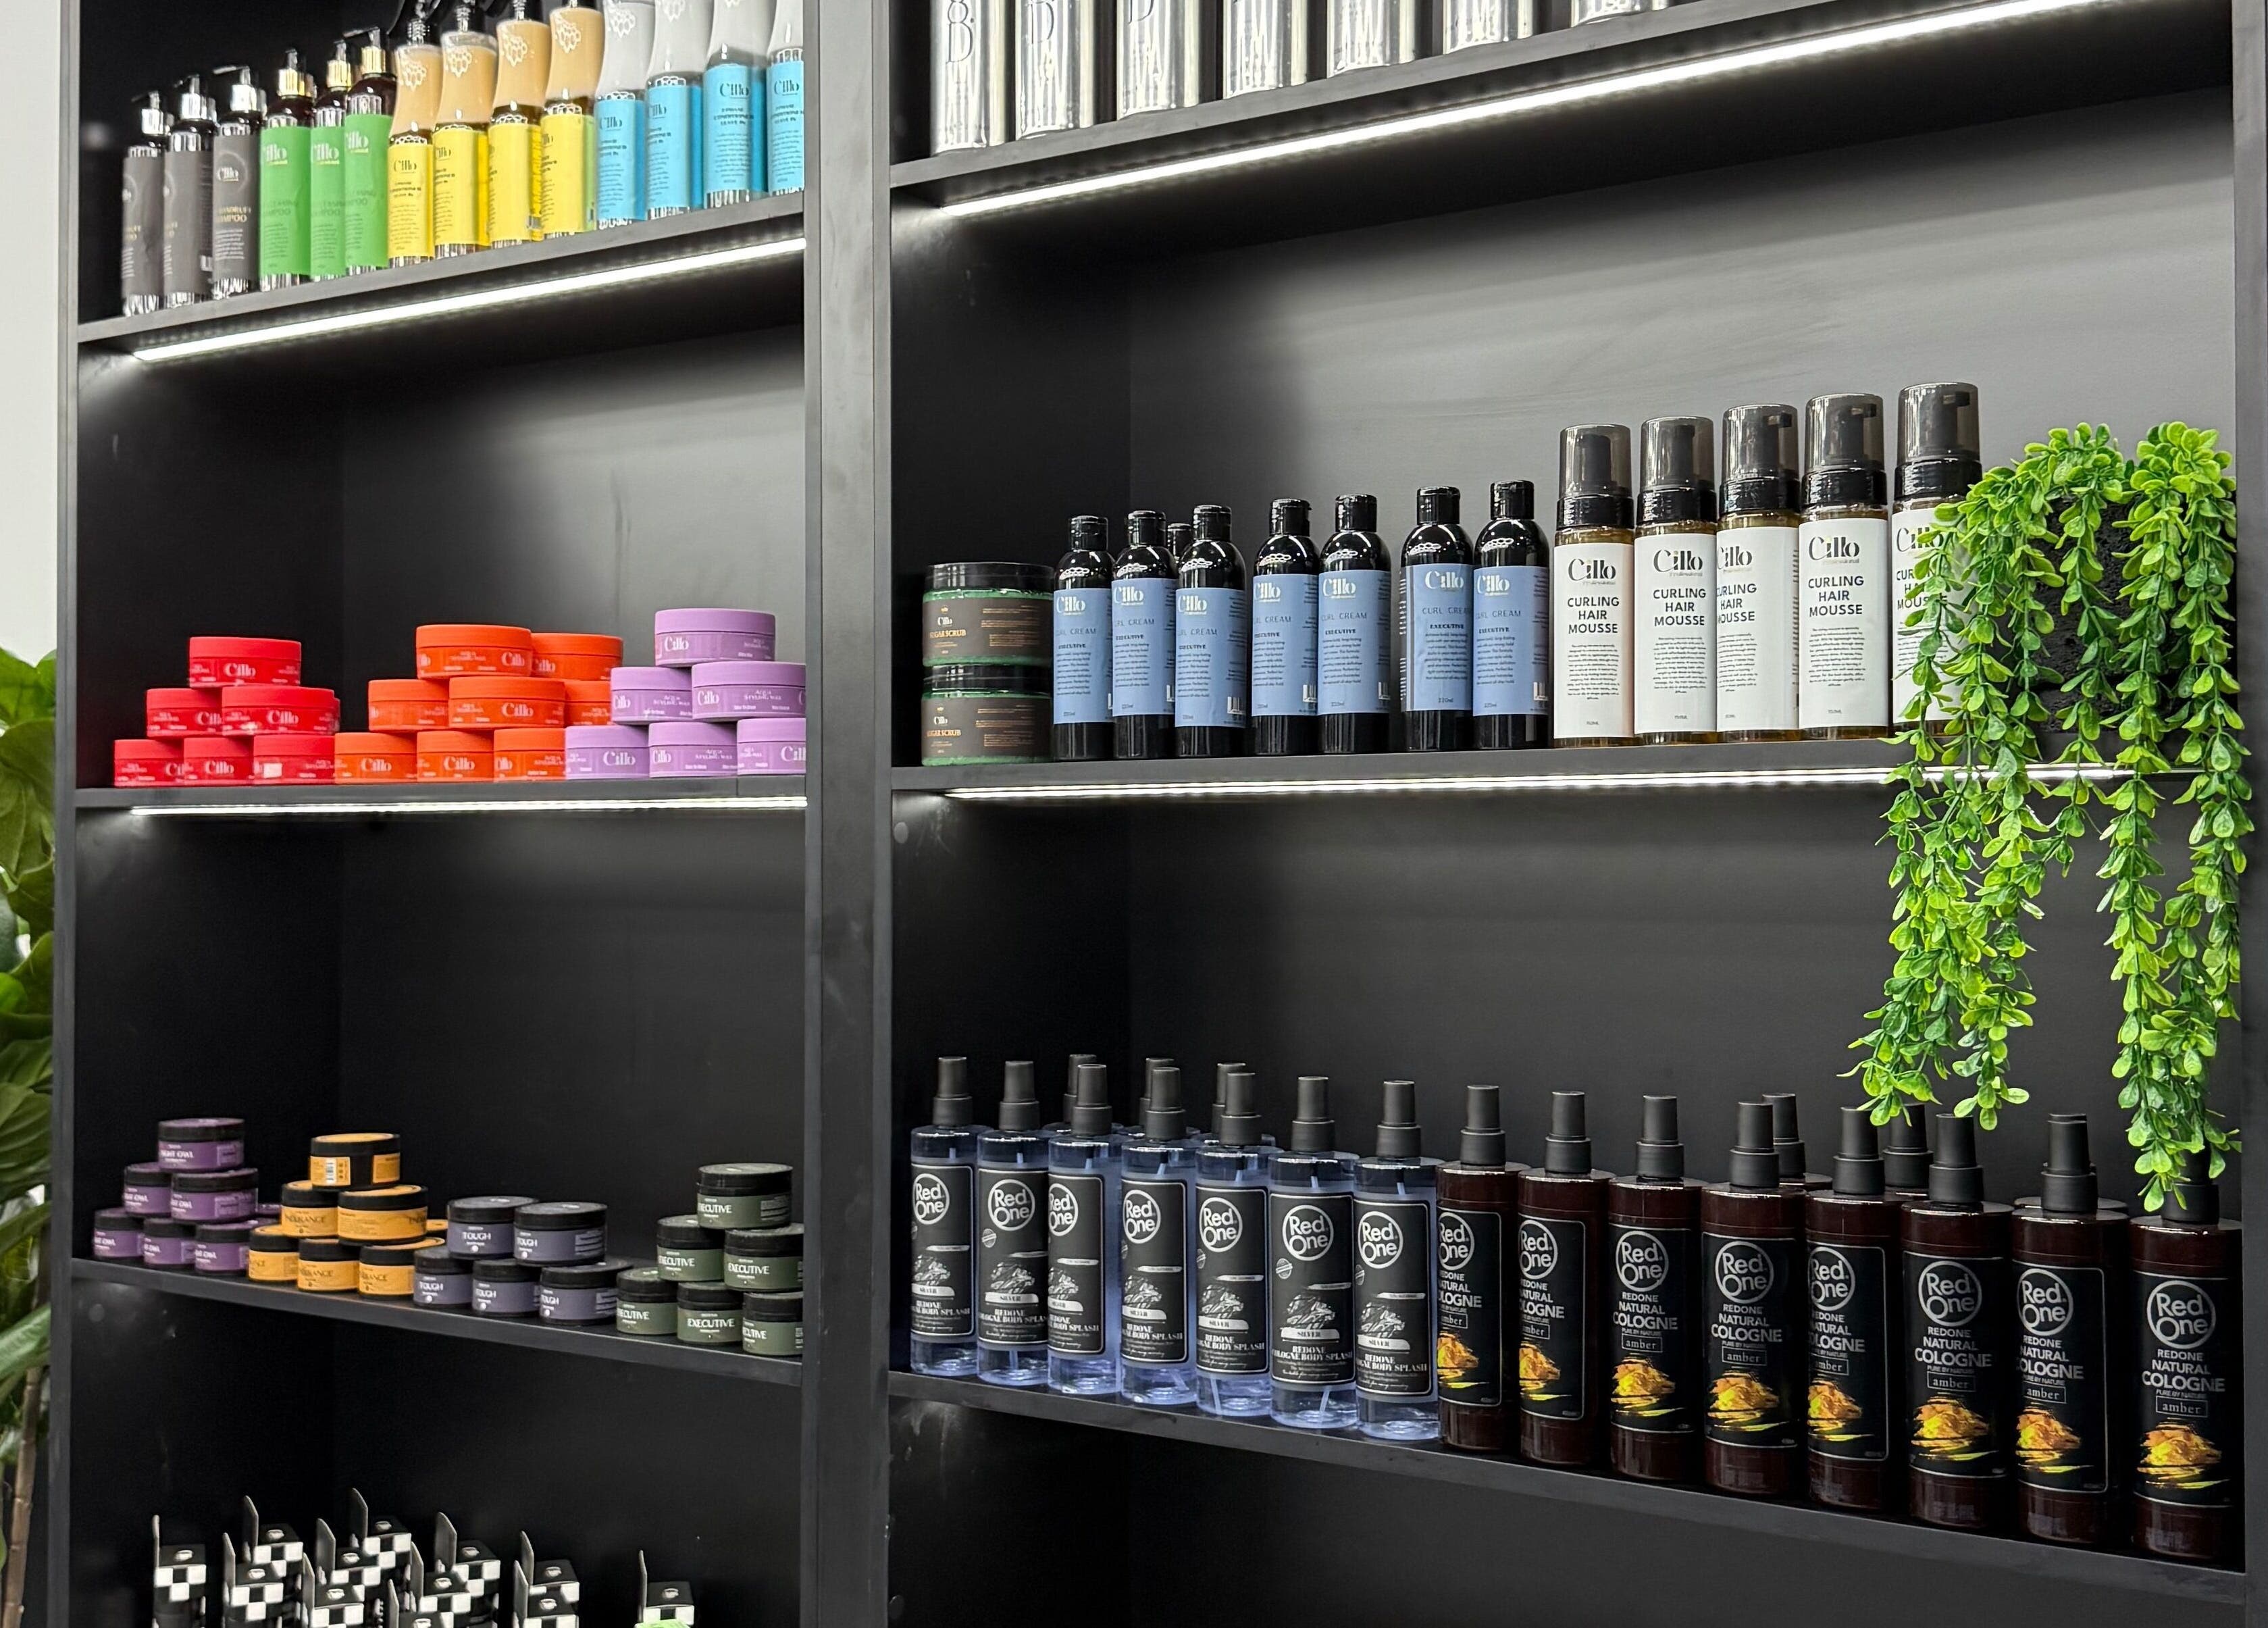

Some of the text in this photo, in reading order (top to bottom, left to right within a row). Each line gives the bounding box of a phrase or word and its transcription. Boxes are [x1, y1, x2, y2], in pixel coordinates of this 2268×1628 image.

[1809, 536, 1859, 561] Cillo
[1653, 549, 1703, 573] Cillo
[1568, 558, 1616, 581] Cillo
[1322, 578, 1356, 596] Cillo
[1425, 571, 1464, 589] Cillo
[1476, 574, 1510, 594] Cillo
[1808, 576, 1864, 588] CURLING
[1653, 588, 1706, 599] CURLING
[1819, 590, 1850, 602] HAIR
[1567, 596, 1620, 607] CURLING
[1666, 602, 1695, 612] HAIR
[1720, 598, 1743, 610] HAIR
[1339, 611, 1368, 619] CREAM
[1492, 610, 1521, 618] CREAM
[1578, 610, 1607, 620] HAIR
[1809, 604, 1863, 617] MOUSSE
[1129, 618, 1155, 626] CREAM
[1265, 615, 1291, 624] CREAM
[1654, 615, 1705, 626] MOUSSE
[1568, 624, 1618, 634] MOUSSE
[664, 636, 689, 652] Cillo
[224, 663, 256, 677] Cillo
[500, 702, 534, 717] Cillo
[266, 710, 299, 725] Cillo
[361, 757, 392, 772] Cillo
[443, 756, 475, 771] Cillo
[603, 751, 636, 766] Cillo
[205, 761, 235, 775] Cillo
[916, 1183, 942, 1200] Red
[994, 1189, 1027, 1207] Red
[915, 1200, 944, 1218] One
[994, 1206, 1030, 1225] One
[1126, 1200, 1152, 1218] Red
[1204, 1207, 1233, 1227] Red
[1125, 1218, 1156, 1237] One
[1289, 1215, 1325, 1236] Red
[1362, 1222, 1394, 1242] Red
[462, 1231, 492, 1240] TOUGH
[1202, 1227, 1237, 1246] One
[1289, 1235, 1328, 1255] One
[1362, 1242, 1397, 1262] One
[1622, 1242, 1658, 1264] Red
[727, 1263, 771, 1275] EXECUTIVE
[1722, 1252, 1763, 1275] Red
[1620, 1263, 1663, 1285] One
[419, 1281, 444, 1291] TOUGH
[1722, 1274, 1768, 1297] One
[1926, 1273, 1970, 1296] Red
[1622, 1292, 1659, 1303] REDONE
[2021, 1281, 2062, 1304] Red
[1618, 1301, 1666, 1315] NATURAL
[1723, 1304, 1764, 1315] REDONE
[1926, 1294, 1975, 1319] One
[2156, 1293, 2202, 1317] Red
[687, 1318, 736, 1328] EXECUTIVE
[1612, 1311, 1678, 1331] COLOGNE
[1718, 1313, 1770, 1327] NATURAL
[2021, 1304, 2066, 1328] One
[1711, 1323, 1783, 1343] COLOGNE
[1928, 1326, 1971, 1338] REDONE
[2155, 1317, 2209, 1341] One
[1626, 1339, 1657, 1350] amber
[1923, 1336, 1979, 1351] NATURAL
[1727, 1352, 1761, 1363] amber
[1914, 1348, 1993, 1368] COLOGNE
[2157, 1349, 2205, 1362] REDONE
[1394, 1363, 1427, 1372] SPLASH
[2152, 1359, 2211, 1375] NATURAL
[1933, 1377, 1969, 1389] amber
[2141, 1371, 2226, 1392] COLOGNE
[2026, 1388, 2060, 1400] amber
[2162, 1402, 2201, 1414] amber
